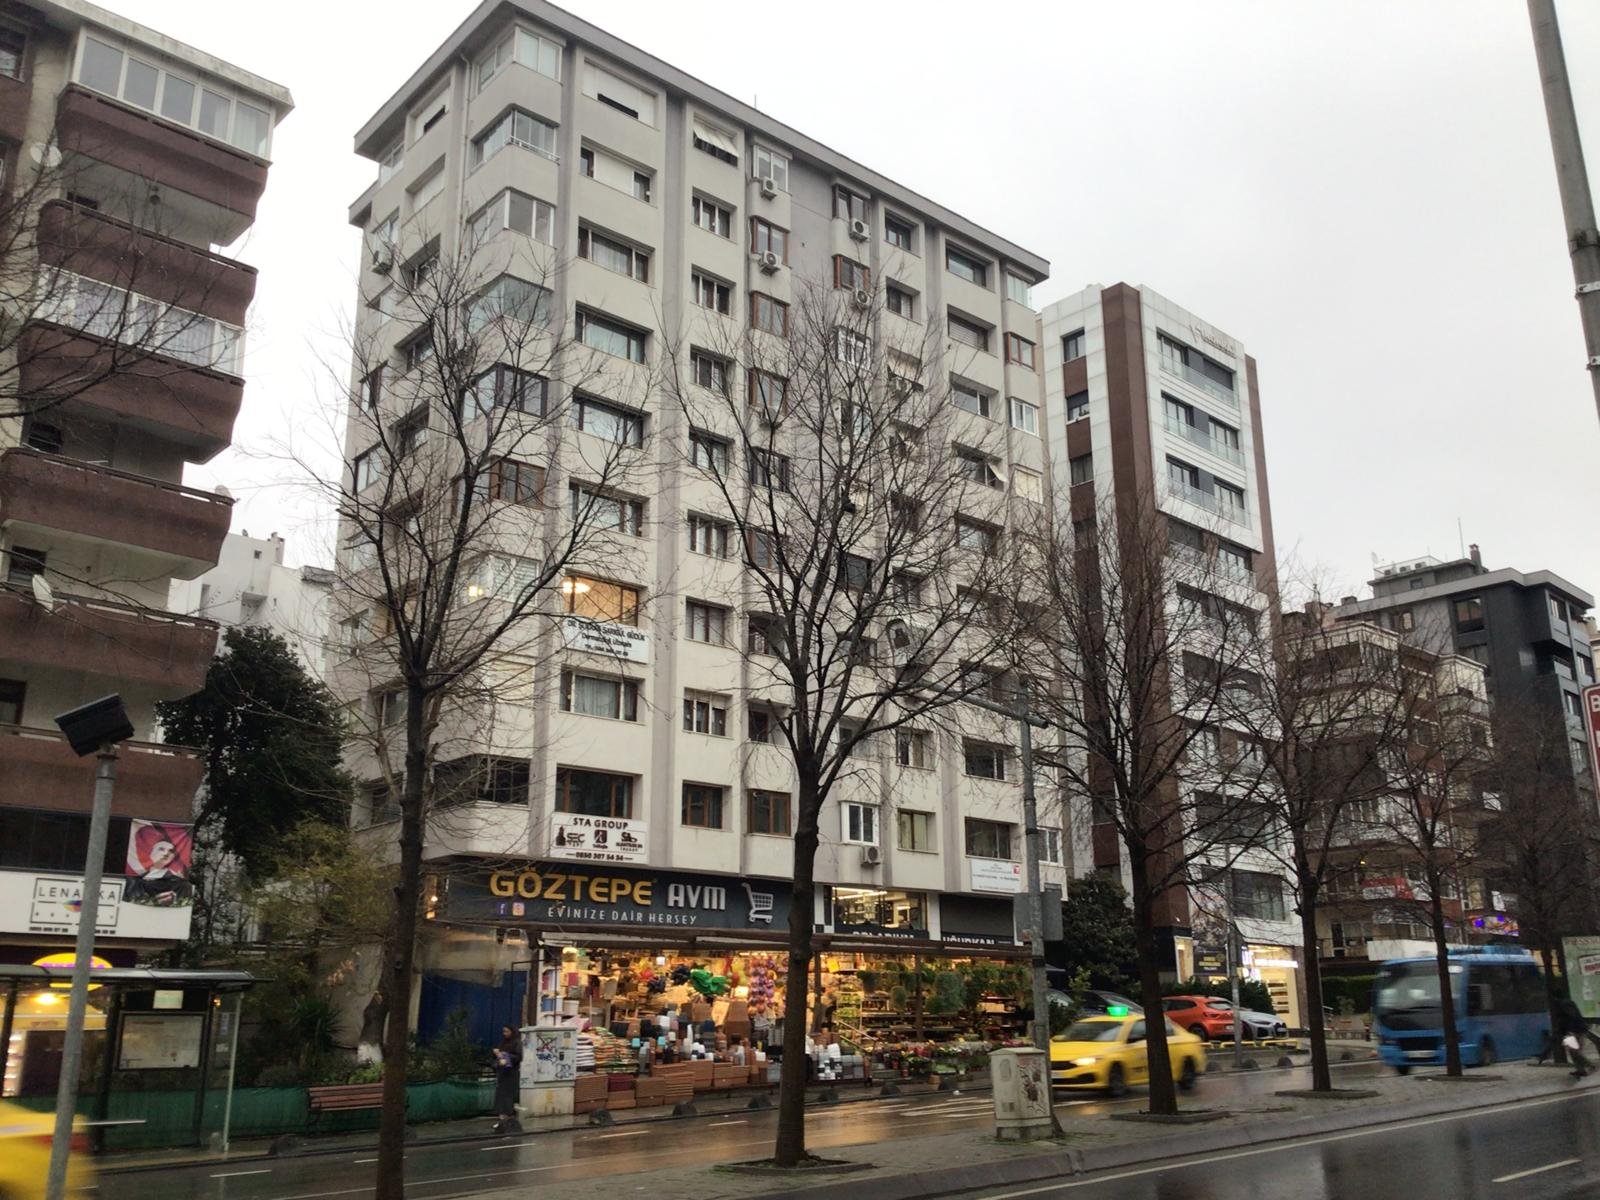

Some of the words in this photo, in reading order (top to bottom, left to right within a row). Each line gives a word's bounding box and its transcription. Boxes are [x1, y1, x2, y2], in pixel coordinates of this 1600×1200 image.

[573, 817, 591, 827] STA
[594, 819, 628, 830] GROUP
[490, 867, 652, 905] GÖZTEPE
[612, 910, 643, 922] DAİR
